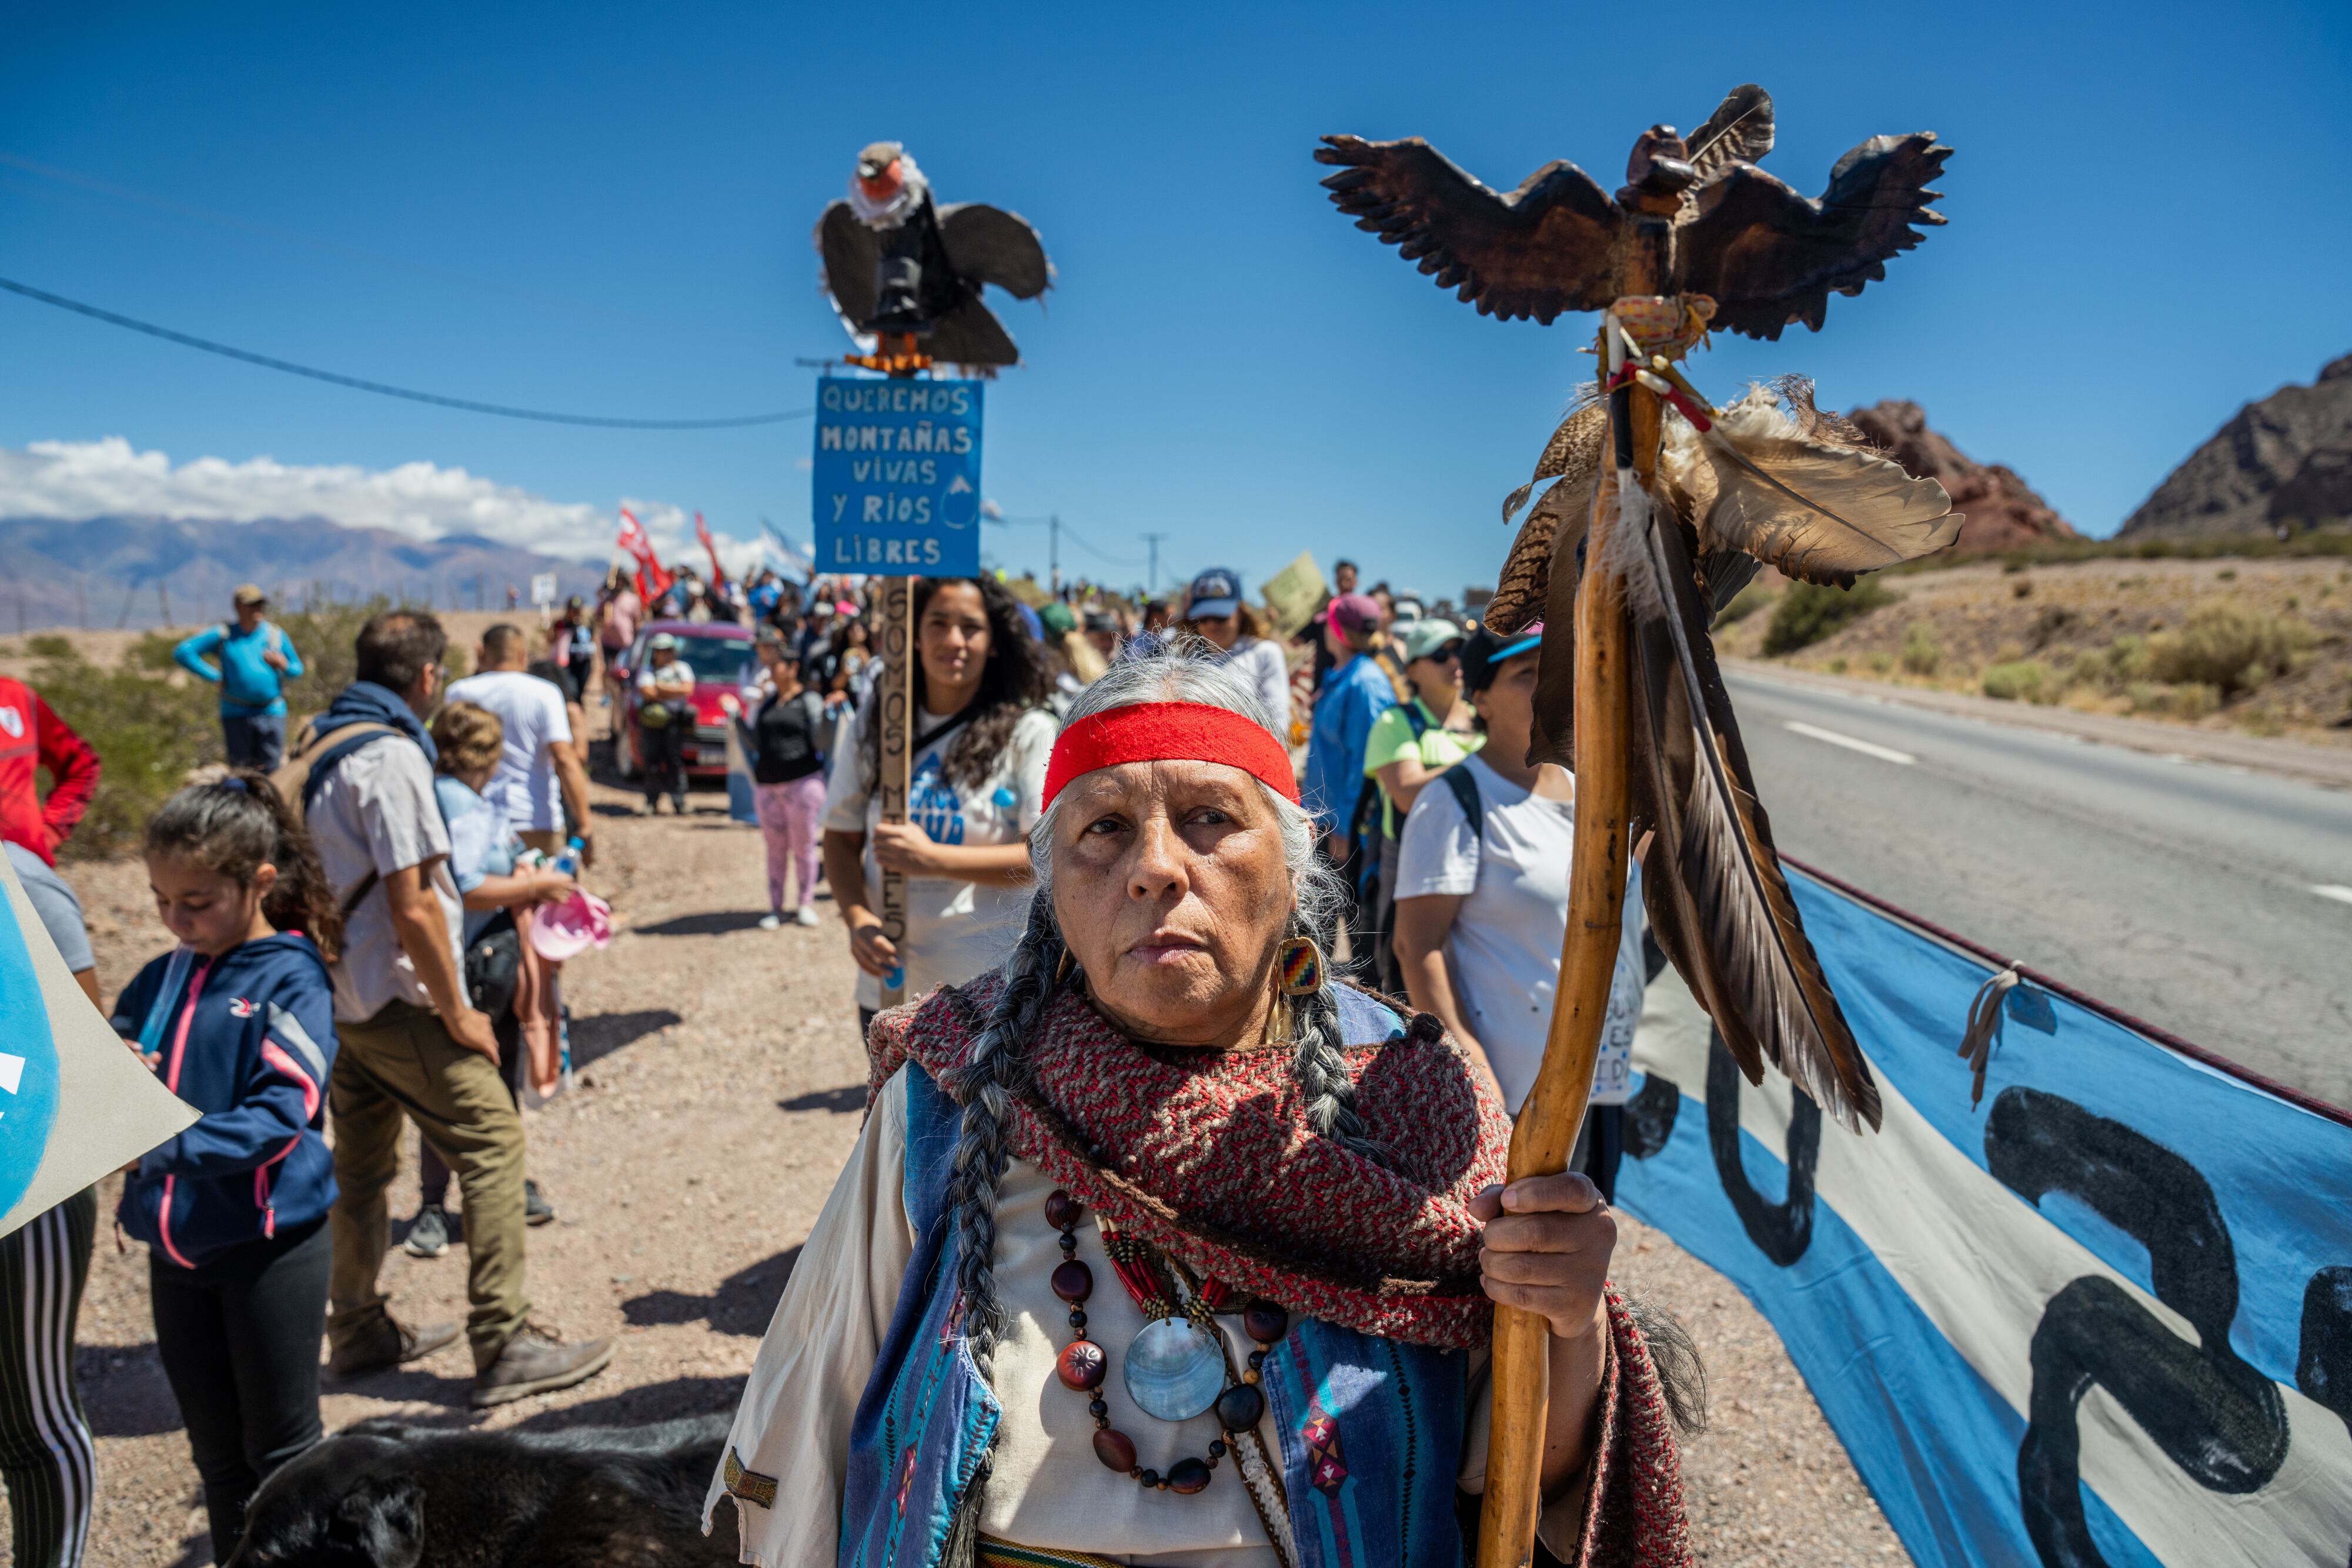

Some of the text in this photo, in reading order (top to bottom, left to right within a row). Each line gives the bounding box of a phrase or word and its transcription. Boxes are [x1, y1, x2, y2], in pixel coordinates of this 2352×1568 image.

[823, 385, 969, 415] QUEREMOS
[821, 420, 973, 454] MONTAÑAS
[833, 494, 847, 523] Y
[884, 589, 907, 756] SOMOS
